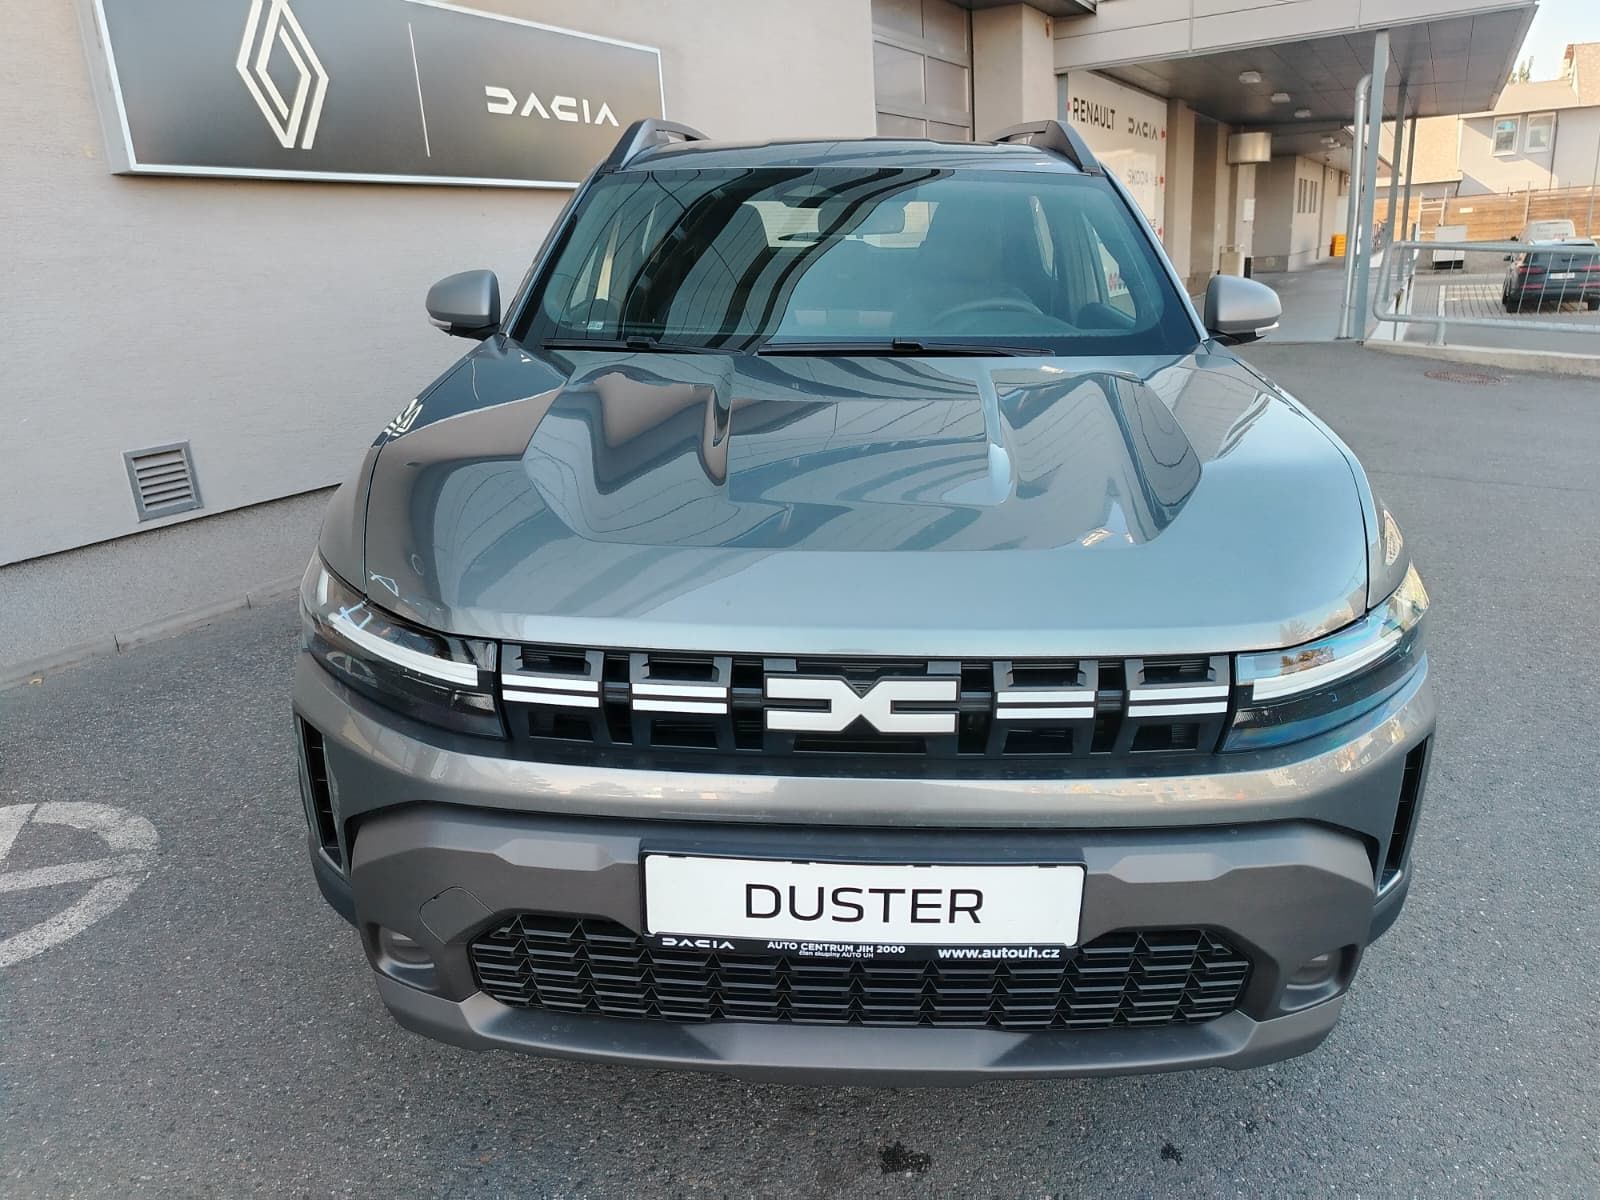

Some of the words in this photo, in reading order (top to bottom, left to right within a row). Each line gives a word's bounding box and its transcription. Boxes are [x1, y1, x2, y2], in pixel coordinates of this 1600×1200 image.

[485, 85, 620, 127] DACIA
[1072, 97, 1116, 130] RENAULT
[1127, 116, 1158, 140] DACIA
[744, 883, 984, 925] DUSTER
[661, 937, 735, 950] DACIA
[767, 941, 798, 951] AUTO
[800, 942, 854, 953] CENTRUM
[856, 944, 874, 954] JIH
[877, 945, 906, 954] 2000
[938, 946, 1060, 959] www.autouh.cz
